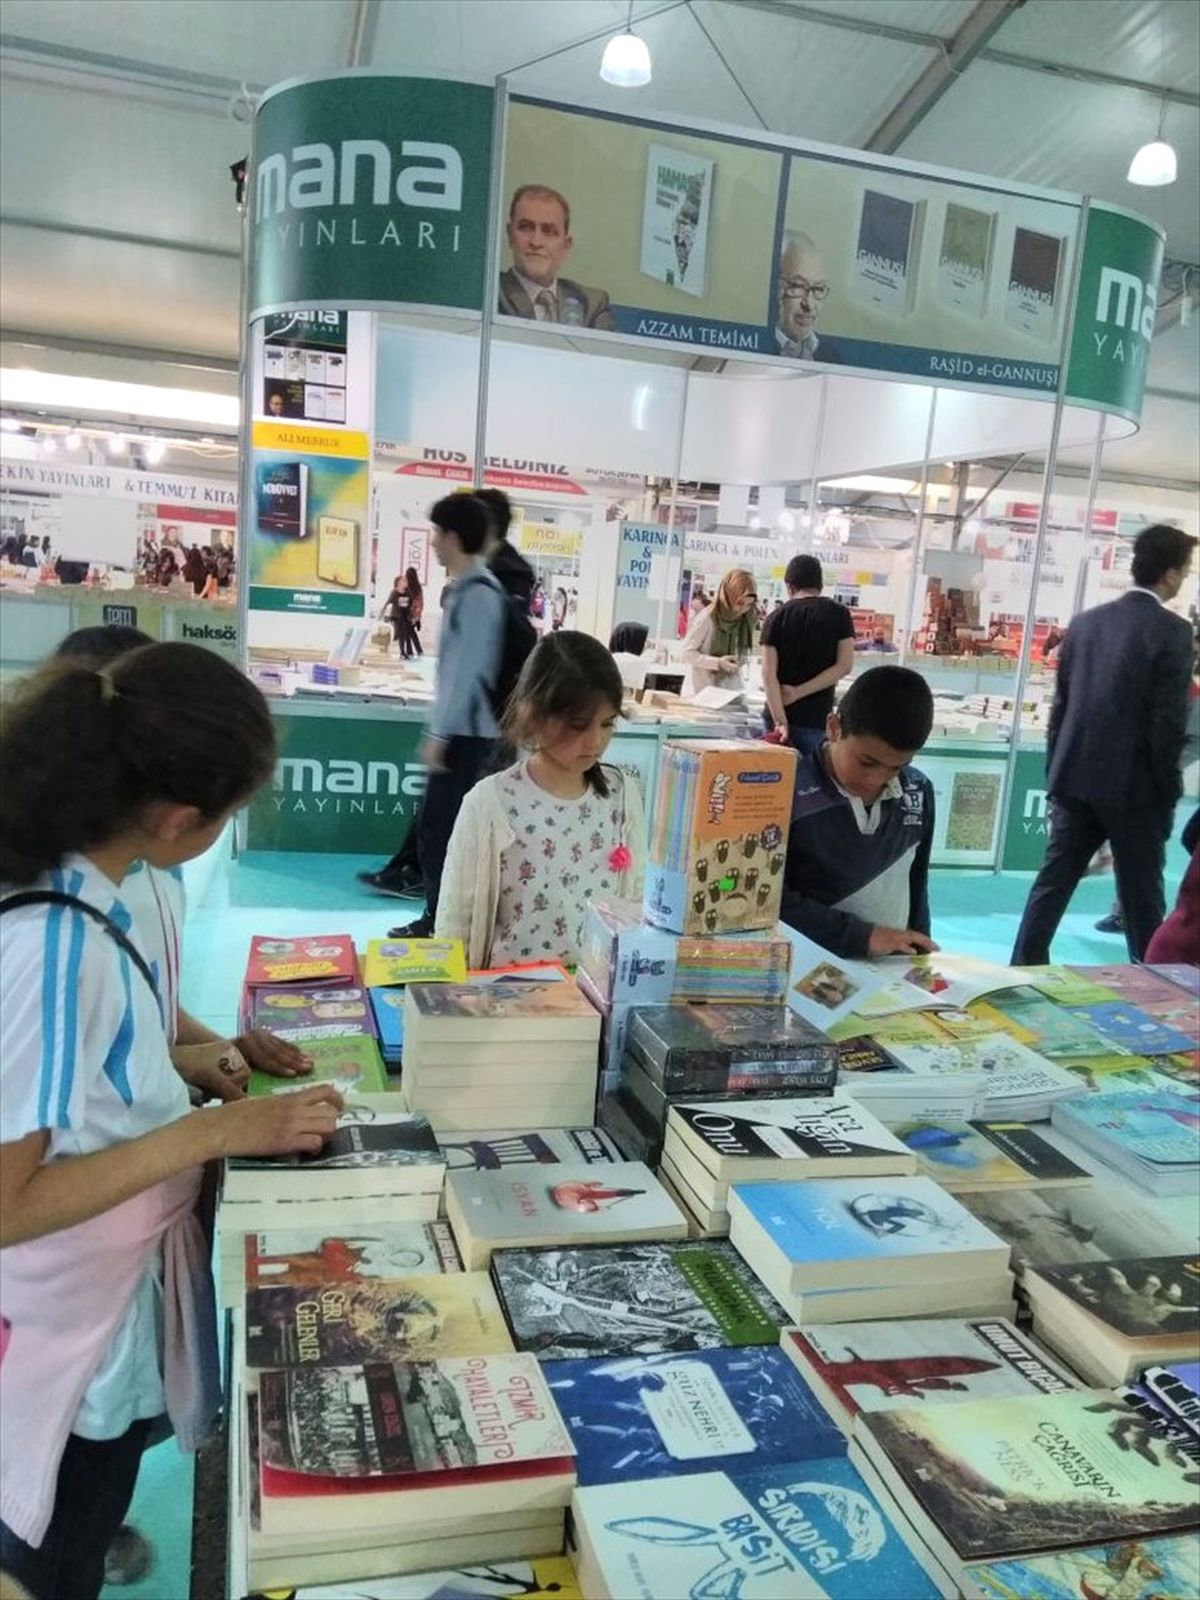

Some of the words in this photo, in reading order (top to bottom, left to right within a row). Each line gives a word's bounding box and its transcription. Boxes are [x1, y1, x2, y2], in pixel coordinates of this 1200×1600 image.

[256, 140, 463, 224] mana
[277, 218, 460, 252] YINLARI
[637, 320, 693, 341] AZZAM
[930, 355, 973, 376] RAŞİD
[39, 469, 111, 489] YAYINLARI
[124, 479, 133, 491] &
[139, 480, 196, 500] TEMMUZ
[275, 758, 427, 795] mana
[692, 1113, 751, 1155] Onu
[295, 1301, 321, 1363] GELENLER
[980, 1323, 1026, 1364] UMUT
[1038, 1421, 1122, 1500] CANAVARIN
